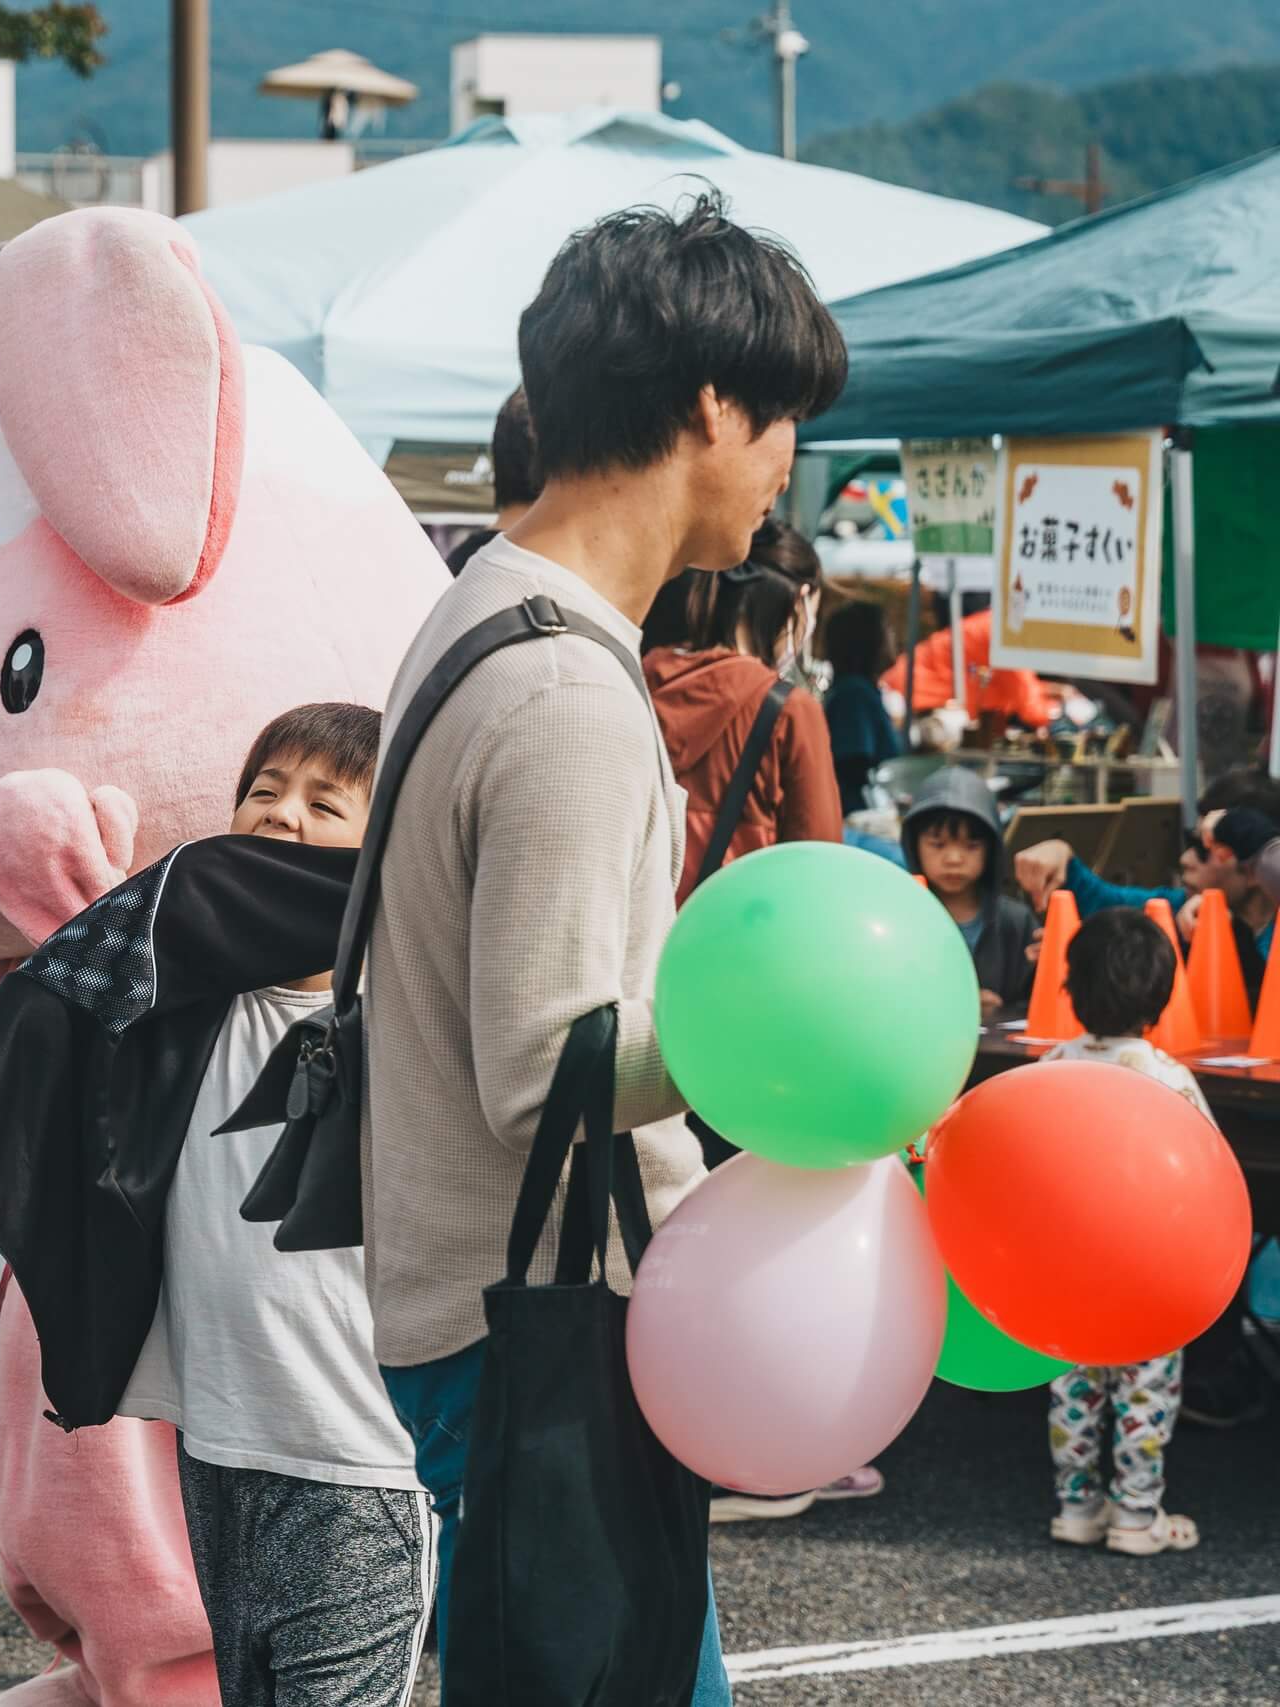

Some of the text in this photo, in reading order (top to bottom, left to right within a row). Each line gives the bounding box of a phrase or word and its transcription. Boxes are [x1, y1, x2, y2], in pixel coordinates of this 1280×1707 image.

[1018, 515, 1133, 563] お菓子すくい
